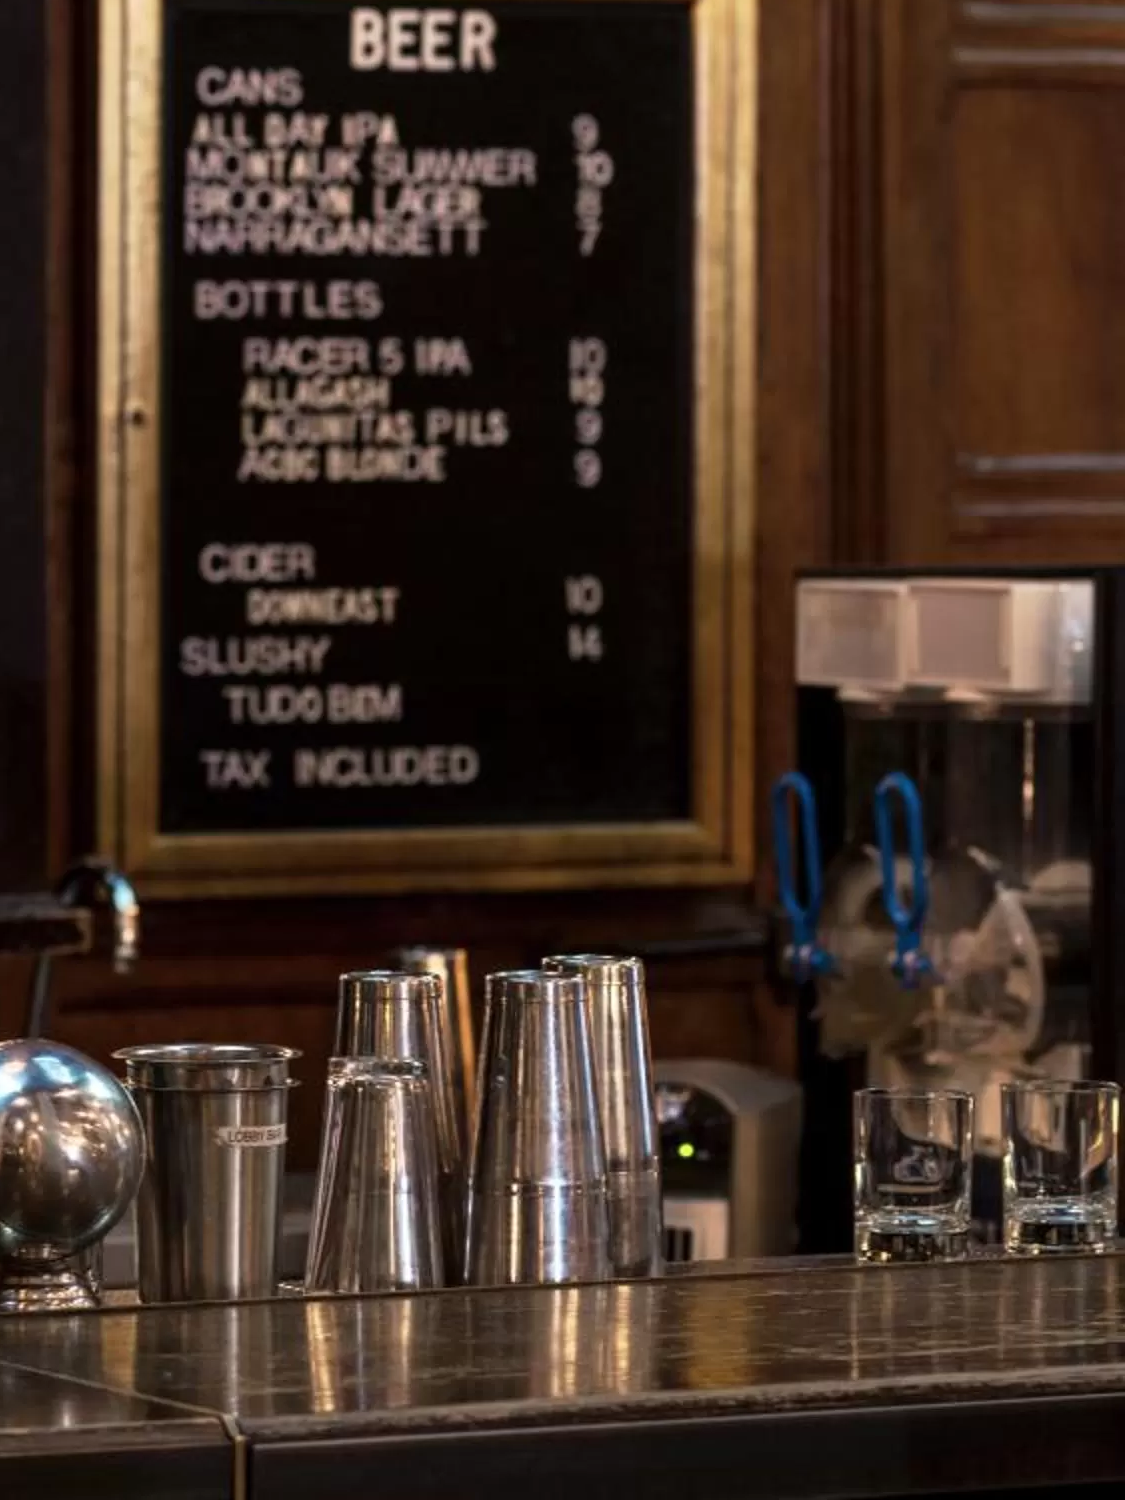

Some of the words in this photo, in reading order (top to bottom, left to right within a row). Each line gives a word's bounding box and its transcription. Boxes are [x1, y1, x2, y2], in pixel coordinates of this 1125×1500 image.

[349, 8, 497, 72] BEER
[195, 66, 303, 107] CANS
[192, 114, 252, 145] ALL
[264, 113, 328, 146] DAY
[342, 113, 398, 145] IPA
[572, 113, 598, 152] 9
[186, 147, 360, 184] MONTAUK
[372, 148, 537, 186] SUMMER
[576, 151, 614, 188] 10
[185, 186, 353, 219] BROOKLYN
[374, 186, 482, 222] LAGER
[185, 218, 486, 256] NARRAGANSETT
[577, 220, 602, 257] 7
[194, 281, 382, 320] BOTTLES
[243, 338, 370, 374] RACER
[379, 338, 404, 375] 5
[415, 338, 472, 375] IPA
[569, 338, 607, 375] 10
[426, 409, 509, 445] PILS
[576, 409, 603, 445] 9
[575, 449, 603, 488] 9
[199, 543, 315, 582] CIDER
[566, 575, 604, 615] 10
[180, 636, 331, 675] SLUSHY
[224, 685, 324, 724] TUDO
[326, 684, 403, 723] BEM
[201, 750, 272, 788] TAX
[293, 746, 480, 787] INCLUDED
